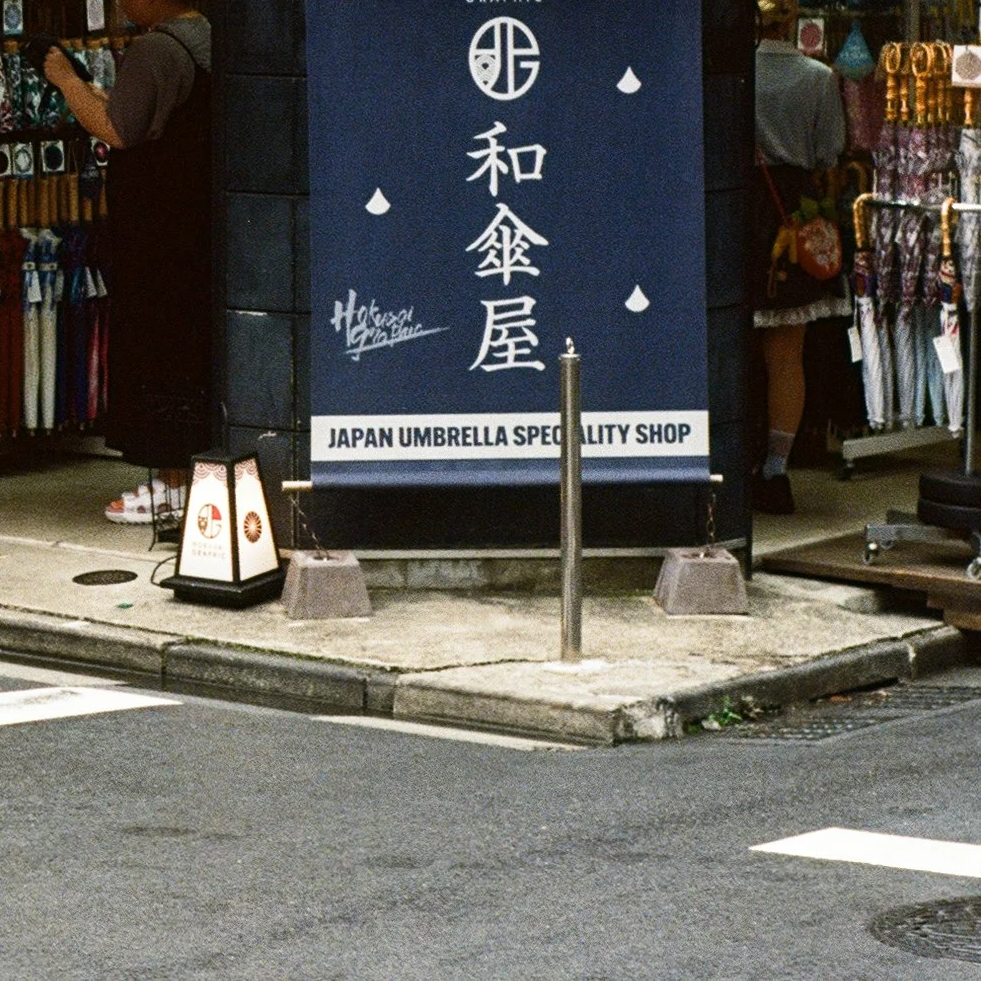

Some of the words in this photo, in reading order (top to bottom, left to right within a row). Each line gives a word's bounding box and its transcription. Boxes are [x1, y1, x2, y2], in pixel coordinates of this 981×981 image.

[466, 121, 549, 372] 和傘屋
[328, 425, 394, 449] JAPAN
[399, 425, 509, 448] UMBRELLA
[513, 424, 630, 447] SPECLITY
[635, 422, 692, 445] SHOP
